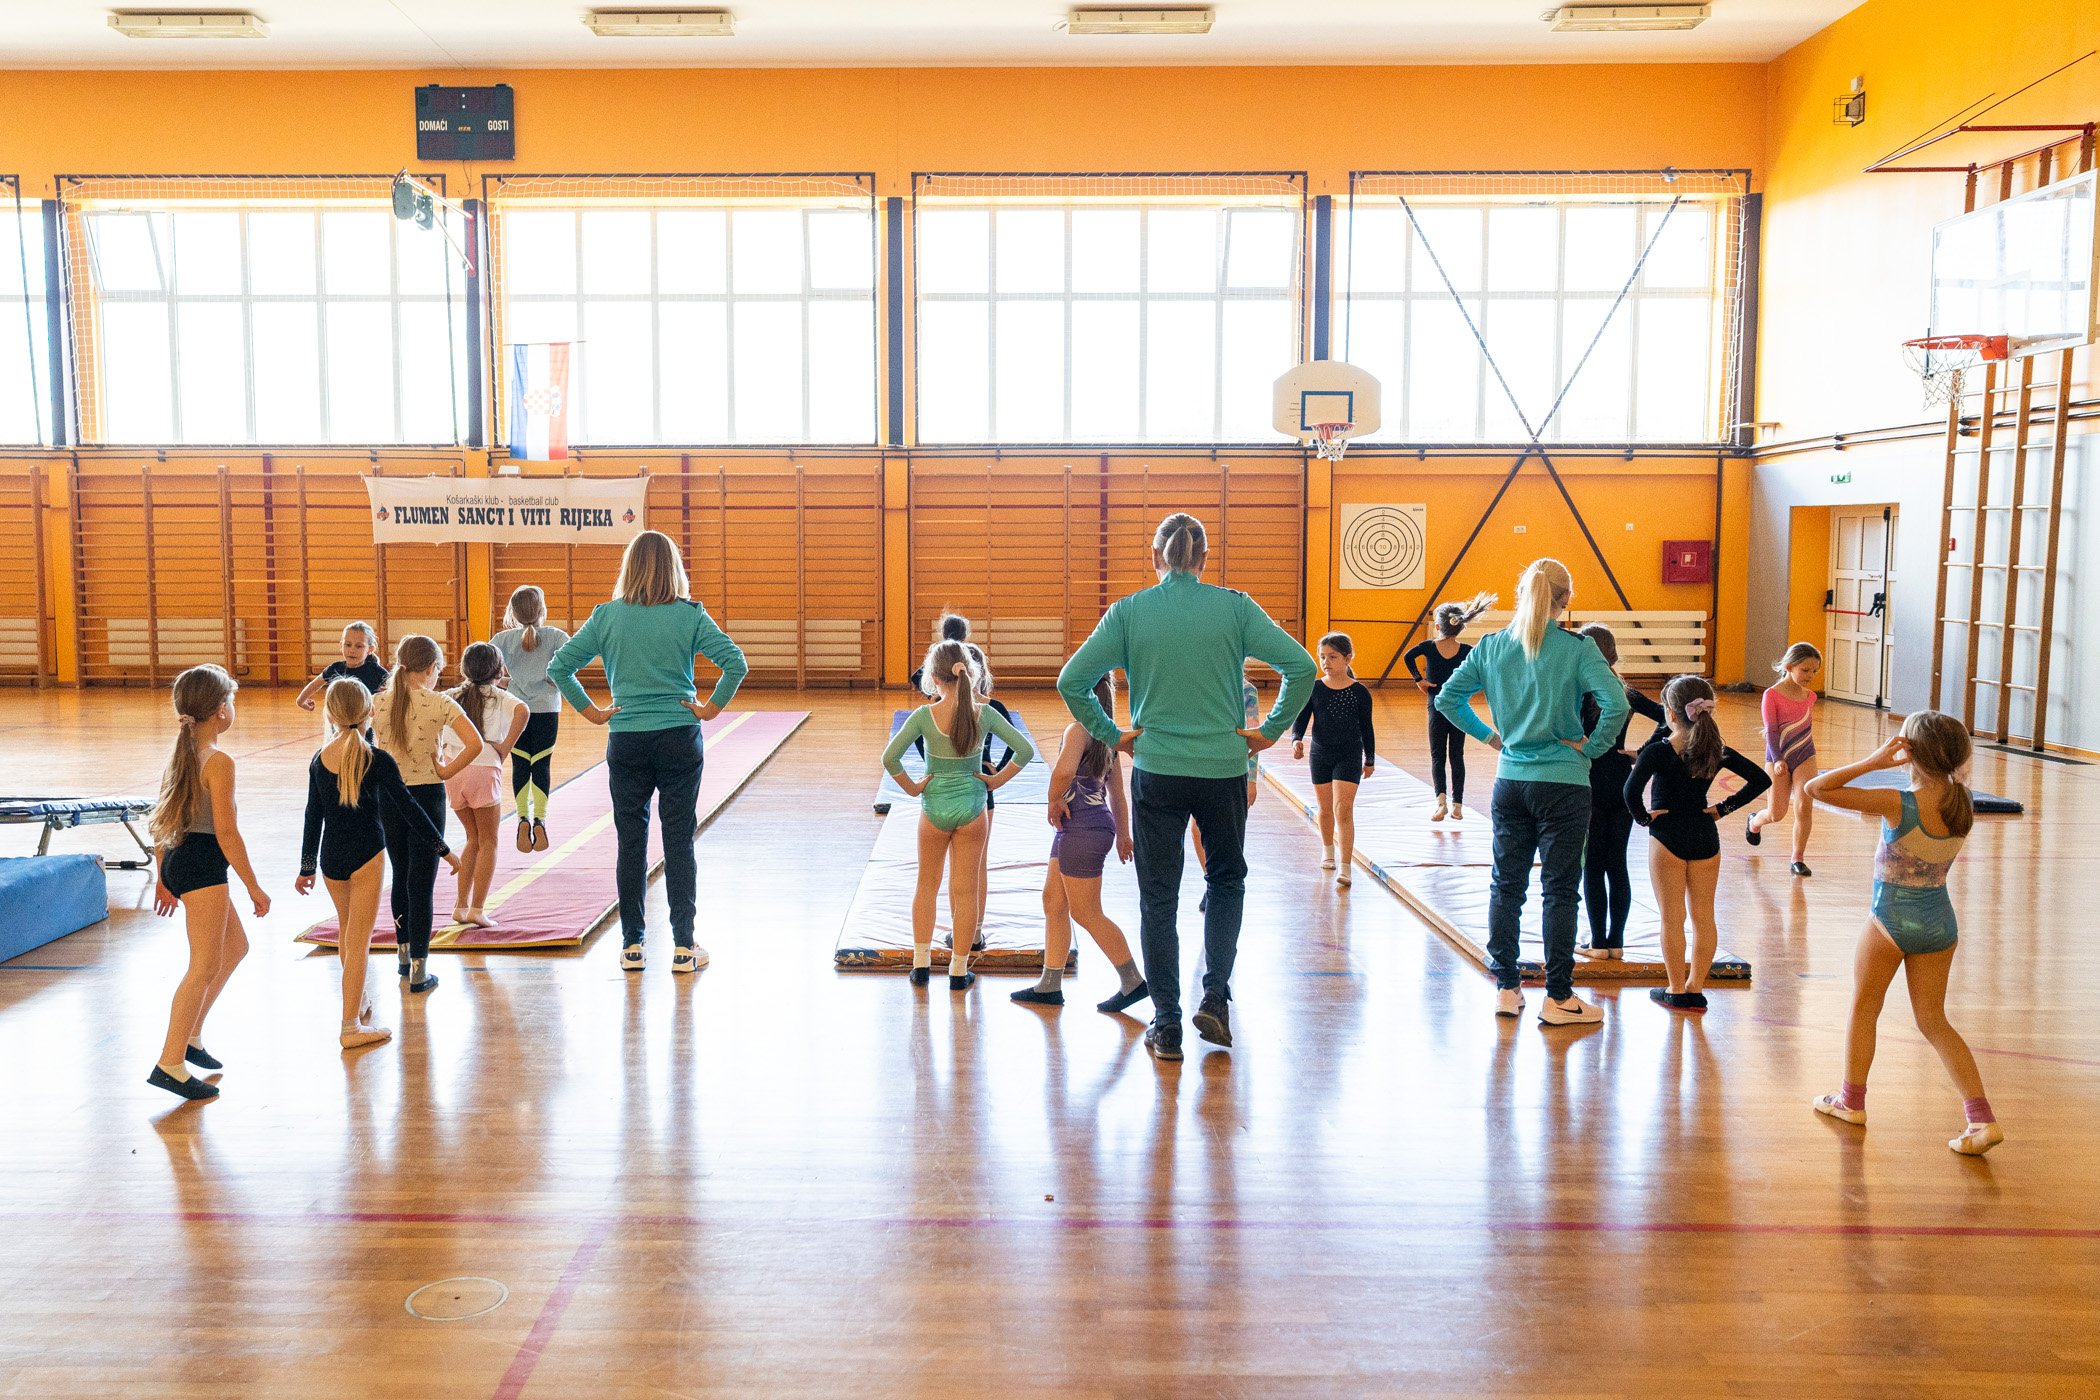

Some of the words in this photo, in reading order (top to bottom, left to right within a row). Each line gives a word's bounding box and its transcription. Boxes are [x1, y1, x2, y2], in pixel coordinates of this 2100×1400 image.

[419, 119, 448, 131] DOMAĆI
[487, 120, 509, 131] GOSTI
[446, 495, 483, 505] Košarkaški
[485, 495, 500, 506] klub
[509, 496, 543, 506] basketball
[544, 496, 559, 506] club
[394, 506, 449, 525] FLUMEN
[520, 508, 551, 526] VITI
[560, 508, 613, 531] RIJEKA
